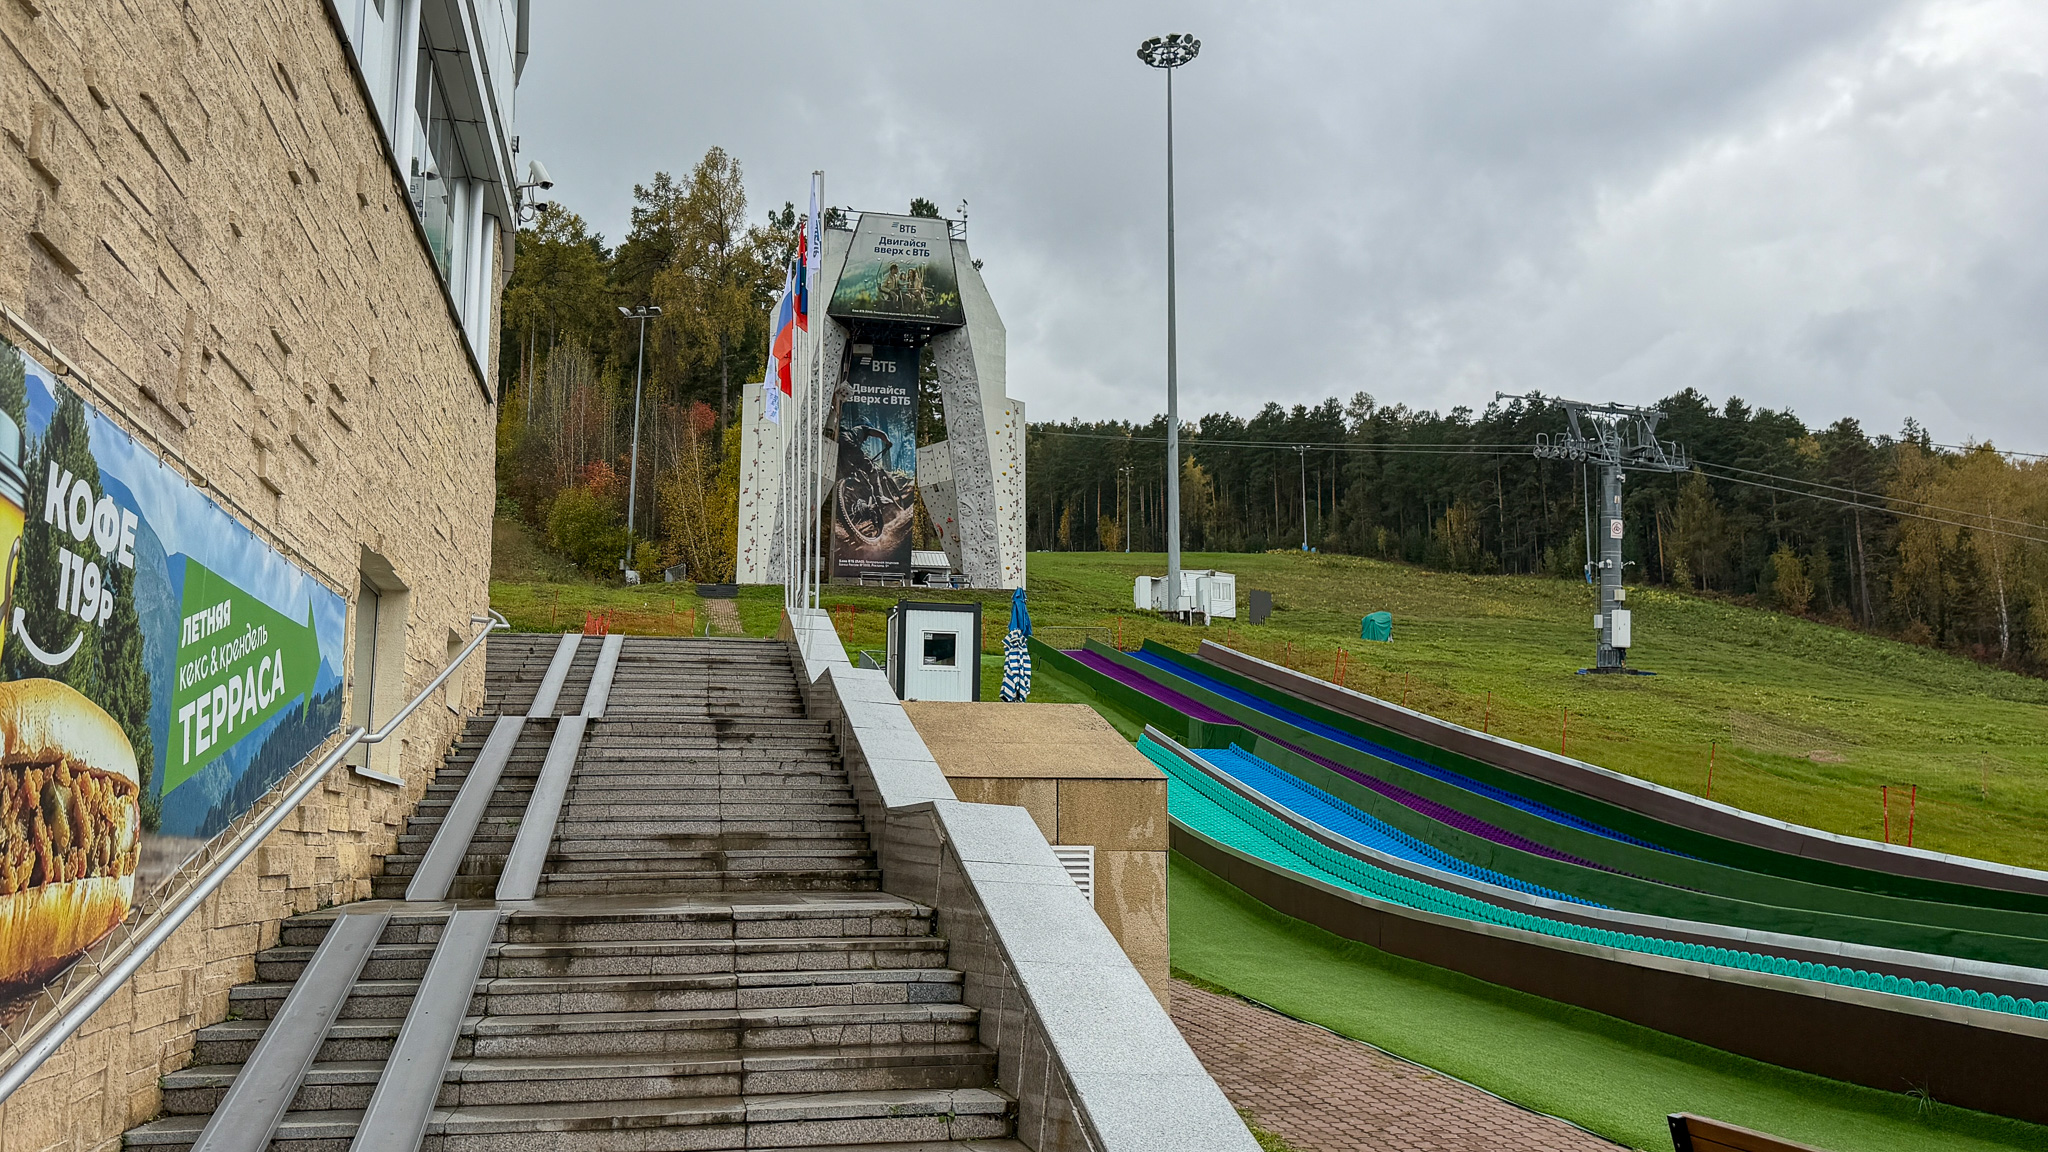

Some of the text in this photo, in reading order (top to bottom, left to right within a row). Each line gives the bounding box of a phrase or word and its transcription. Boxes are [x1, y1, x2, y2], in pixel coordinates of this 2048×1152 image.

[899, 224, 917, 234] ВТБ
[878, 236, 927, 248] Двигайся
[874, 246, 904, 256] вверх
[912, 248, 930, 257] ВТБ
[872, 360, 897, 373] ВТБ
[851, 383, 906, 396] Двигайся
[882, 397, 889, 405] с
[890, 395, 911, 406] ВТБ
[44, 459, 139, 570] КОФЕ
[181, 598, 232, 649] ЛЕТНЯЯ
[179, 622, 269, 692] кекс & крендель
[178, 647, 286, 766] ТЕРРАСА
